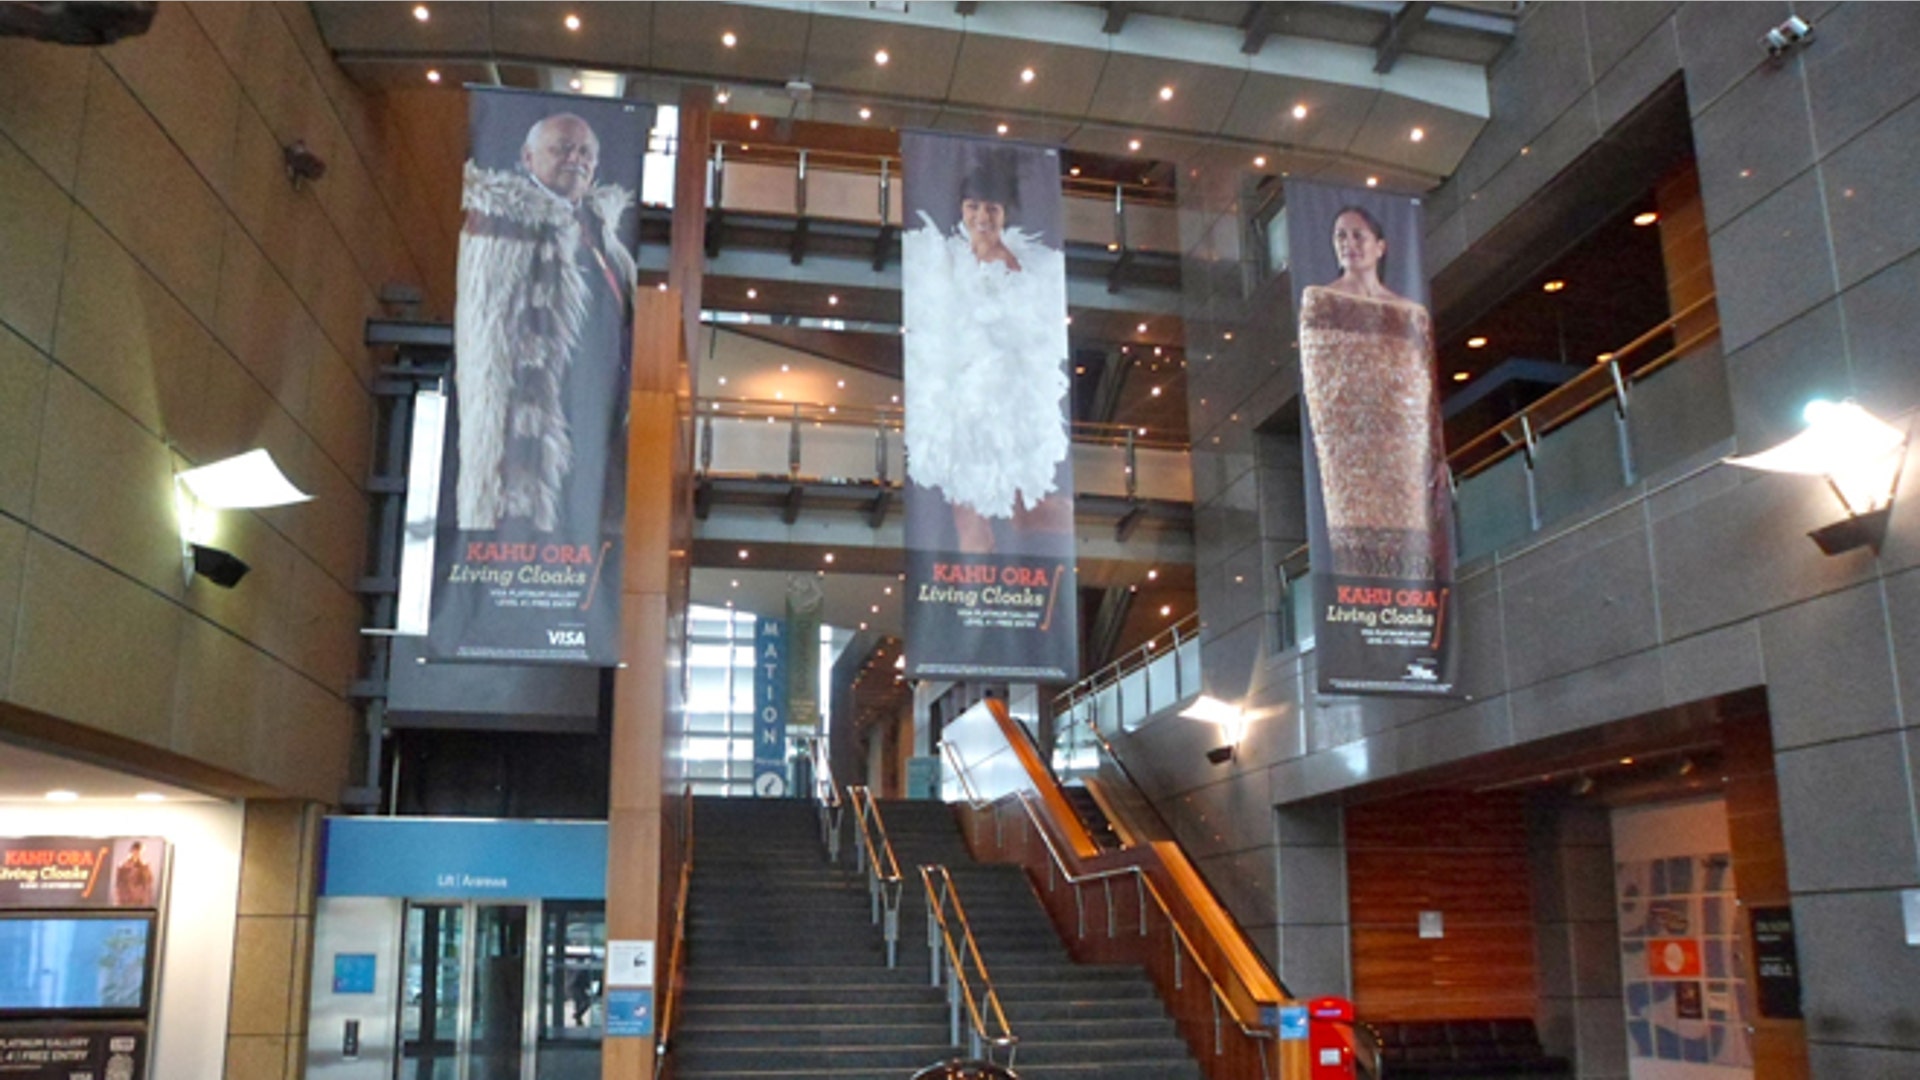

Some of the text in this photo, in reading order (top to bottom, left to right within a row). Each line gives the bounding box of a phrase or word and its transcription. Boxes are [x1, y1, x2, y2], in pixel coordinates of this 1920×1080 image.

[467, 541, 592, 563] KAHU ORA
[449, 564, 586, 586] Living Cloaks
[933, 564, 1048, 586] KAHU ORA
[918, 584, 1044, 607] Living Cloaks
[1338, 586, 1437, 607] KAHU ORA
[1326, 605, 1435, 626] Living Cloaks
[547, 630, 585, 646] VISA
[5, 850, 94, 865] KAHU ORA
[0, 865, 89, 881] iving Cloaks
